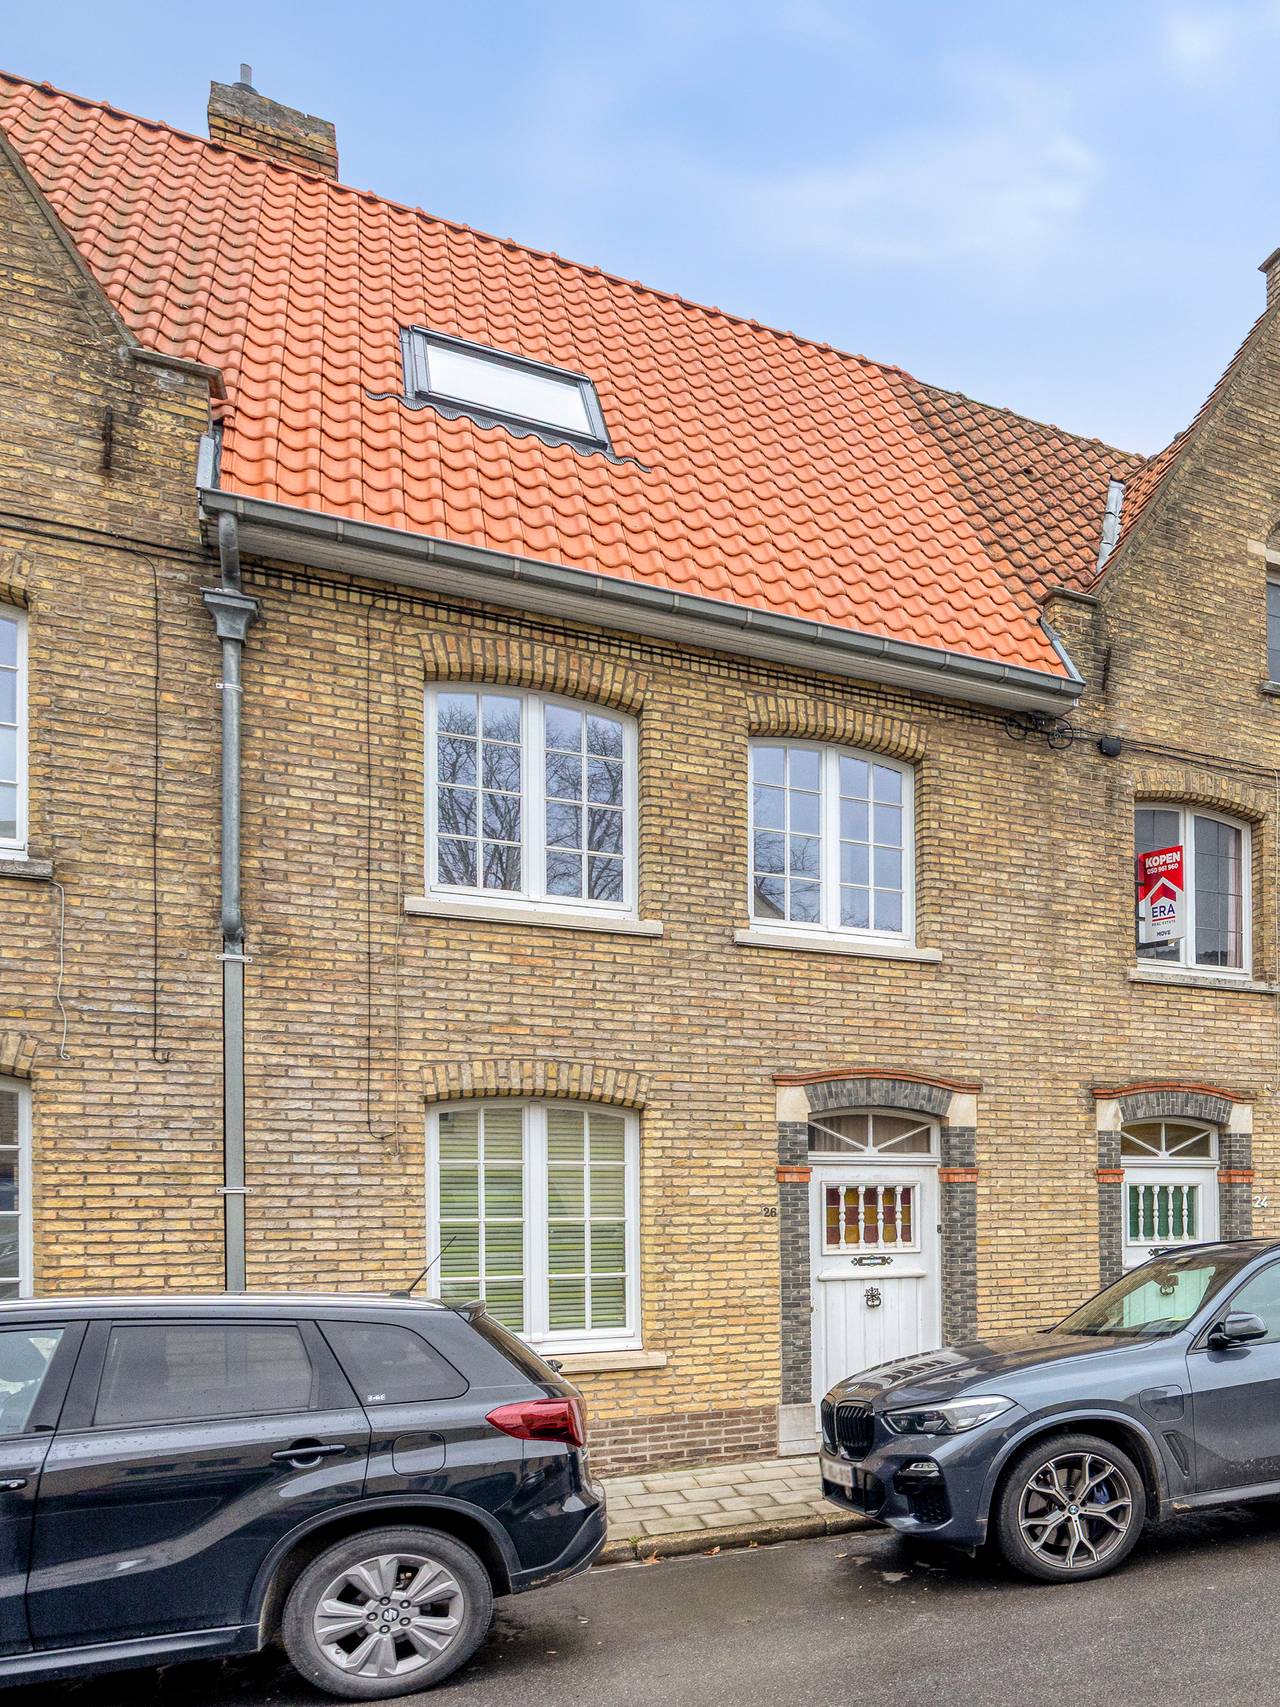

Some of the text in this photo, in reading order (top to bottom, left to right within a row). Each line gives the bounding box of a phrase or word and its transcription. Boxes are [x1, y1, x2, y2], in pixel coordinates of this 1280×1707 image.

[1145, 851, 1181, 868] KOPEN
[1151, 903, 1176, 918] ERA
[1253, 1195, 1268, 1208] 24
[763, 1207, 777, 1218] 26
